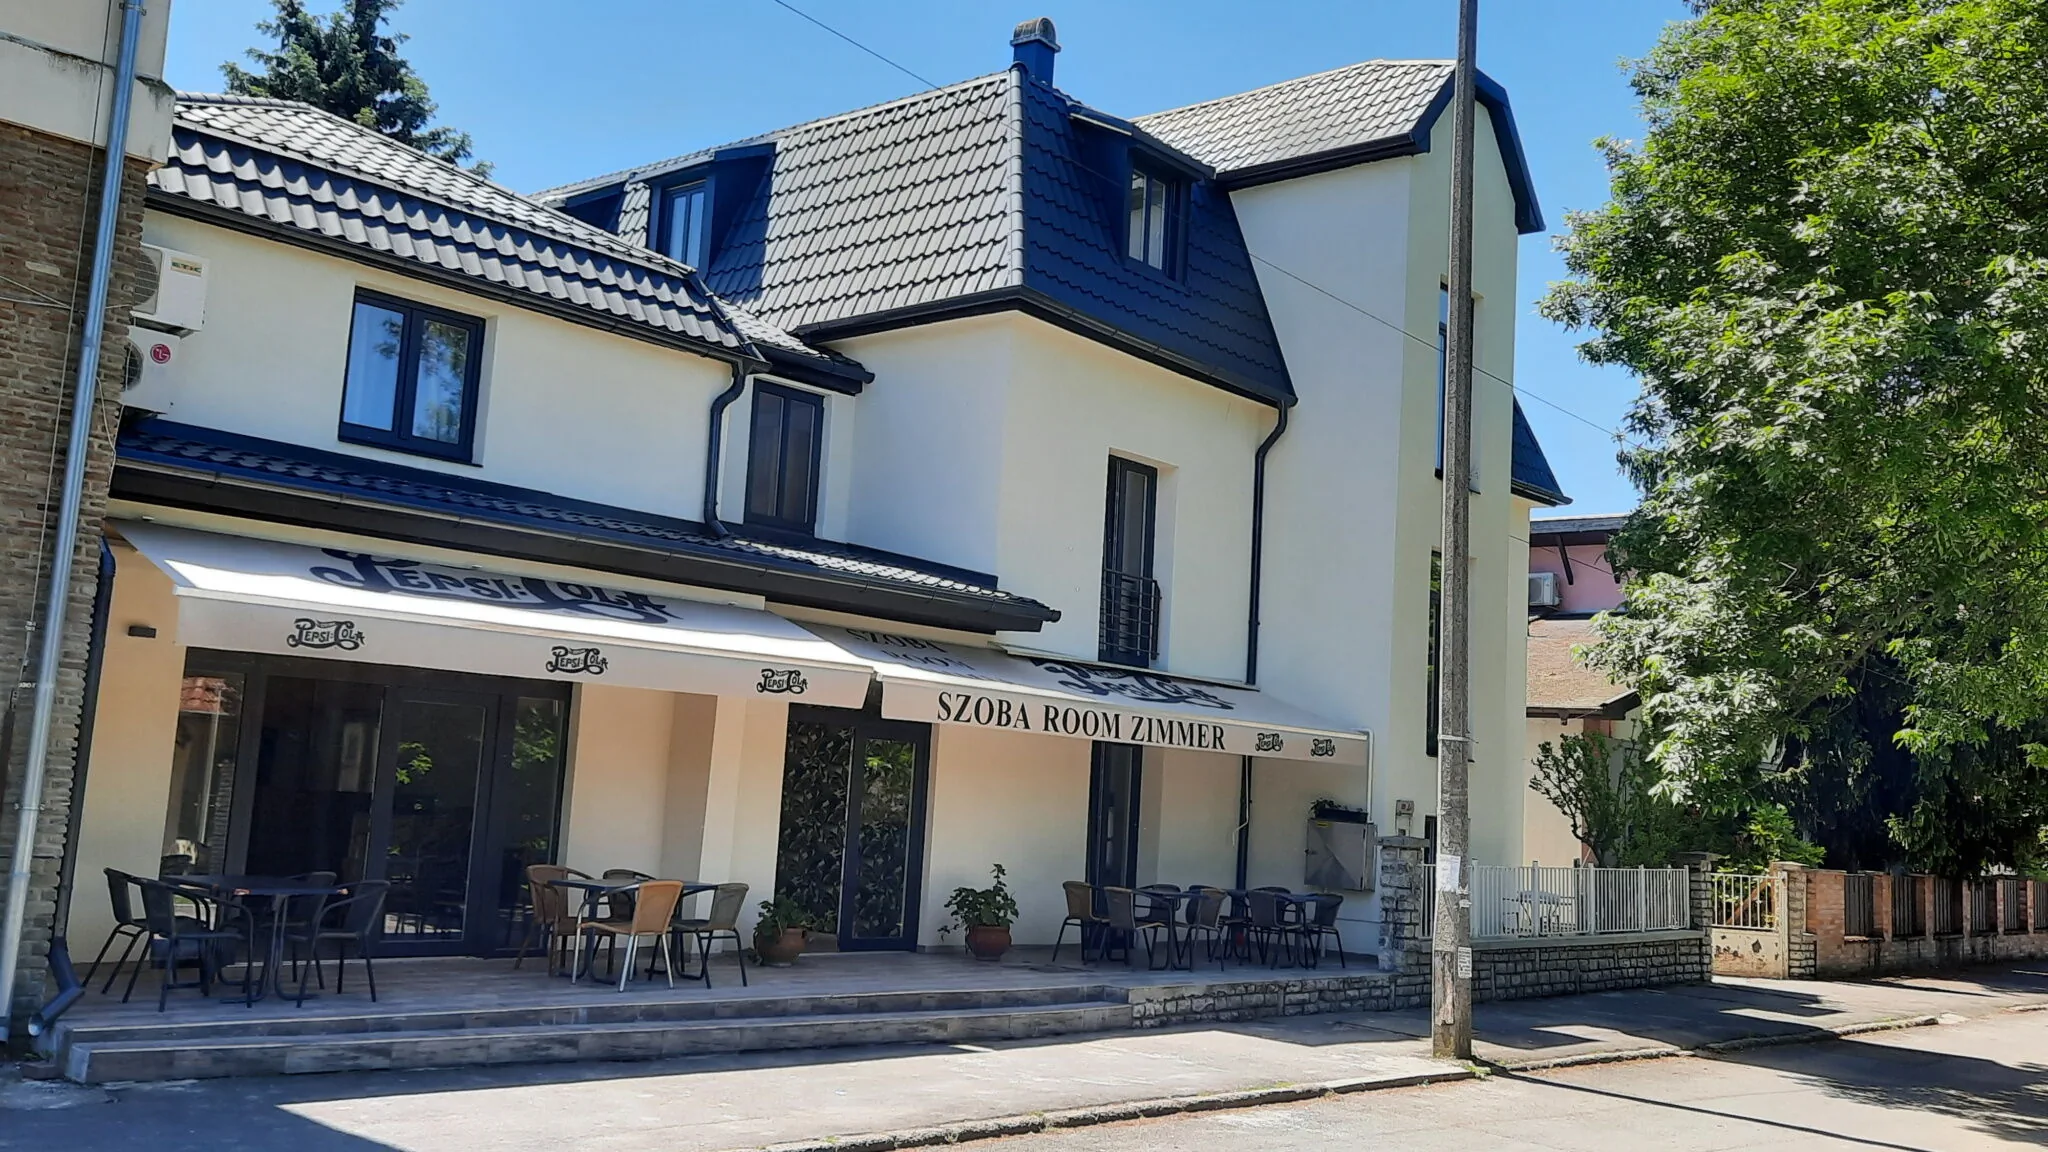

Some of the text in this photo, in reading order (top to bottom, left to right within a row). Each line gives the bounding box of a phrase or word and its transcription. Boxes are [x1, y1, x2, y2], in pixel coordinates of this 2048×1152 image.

[937, 691, 1226, 751] SZOBA ROOM ZIMMER
